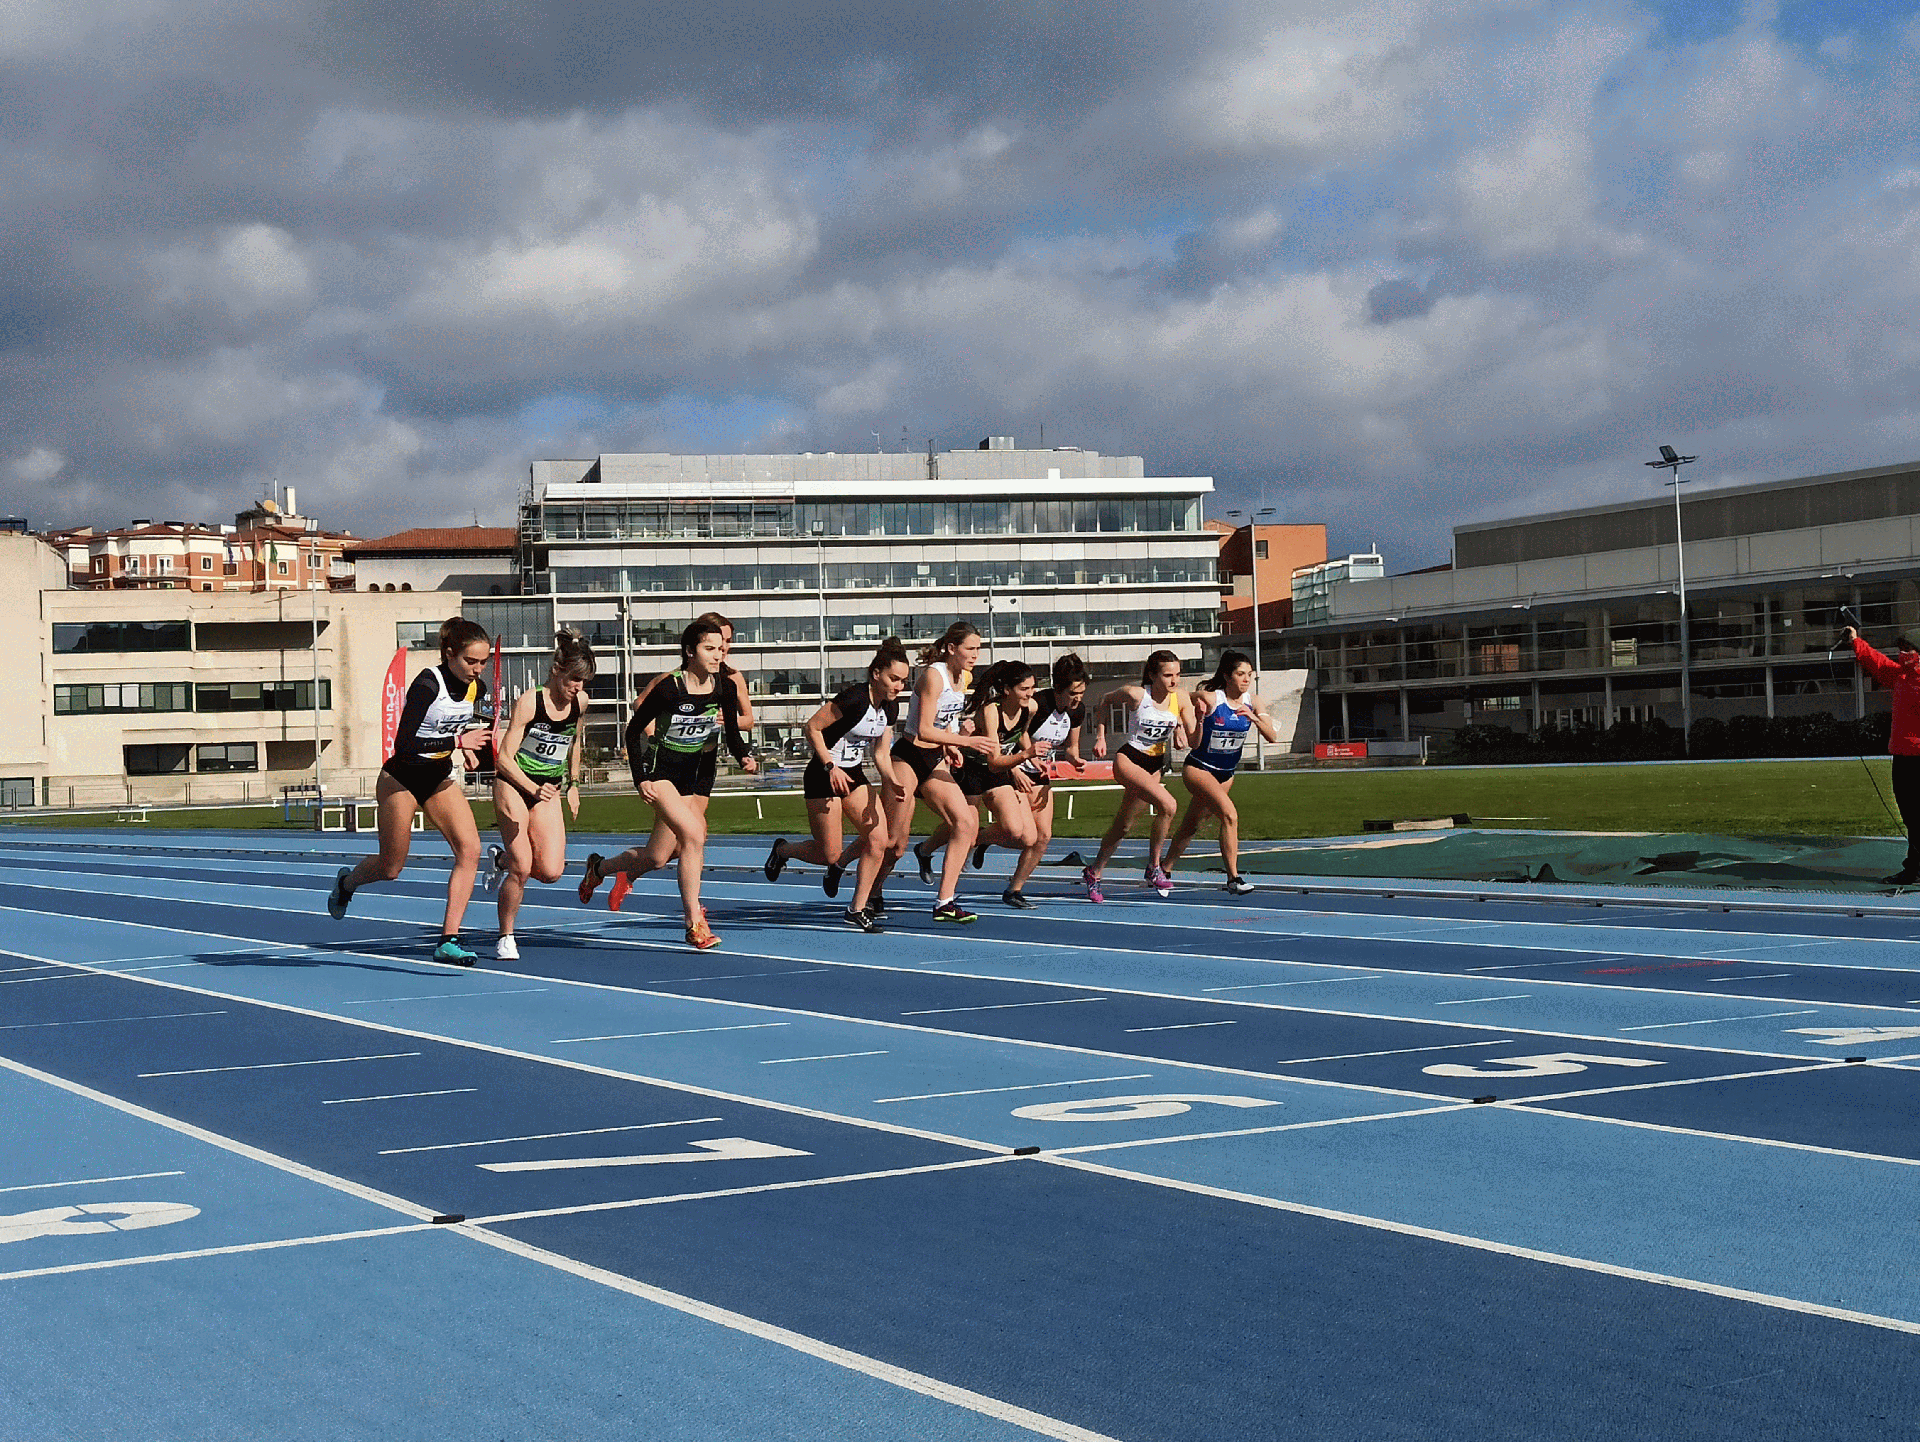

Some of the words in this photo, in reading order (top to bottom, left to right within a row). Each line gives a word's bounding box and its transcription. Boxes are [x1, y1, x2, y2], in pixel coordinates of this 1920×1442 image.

[678, 725, 706, 736] 103
[535, 743, 557, 755] 80
[1221, 739, 1235, 747] 11
[1422, 1052, 1669, 1078] 5
[1010, 1094, 1284, 1122] 6
[475, 1137, 816, 1172] 7
